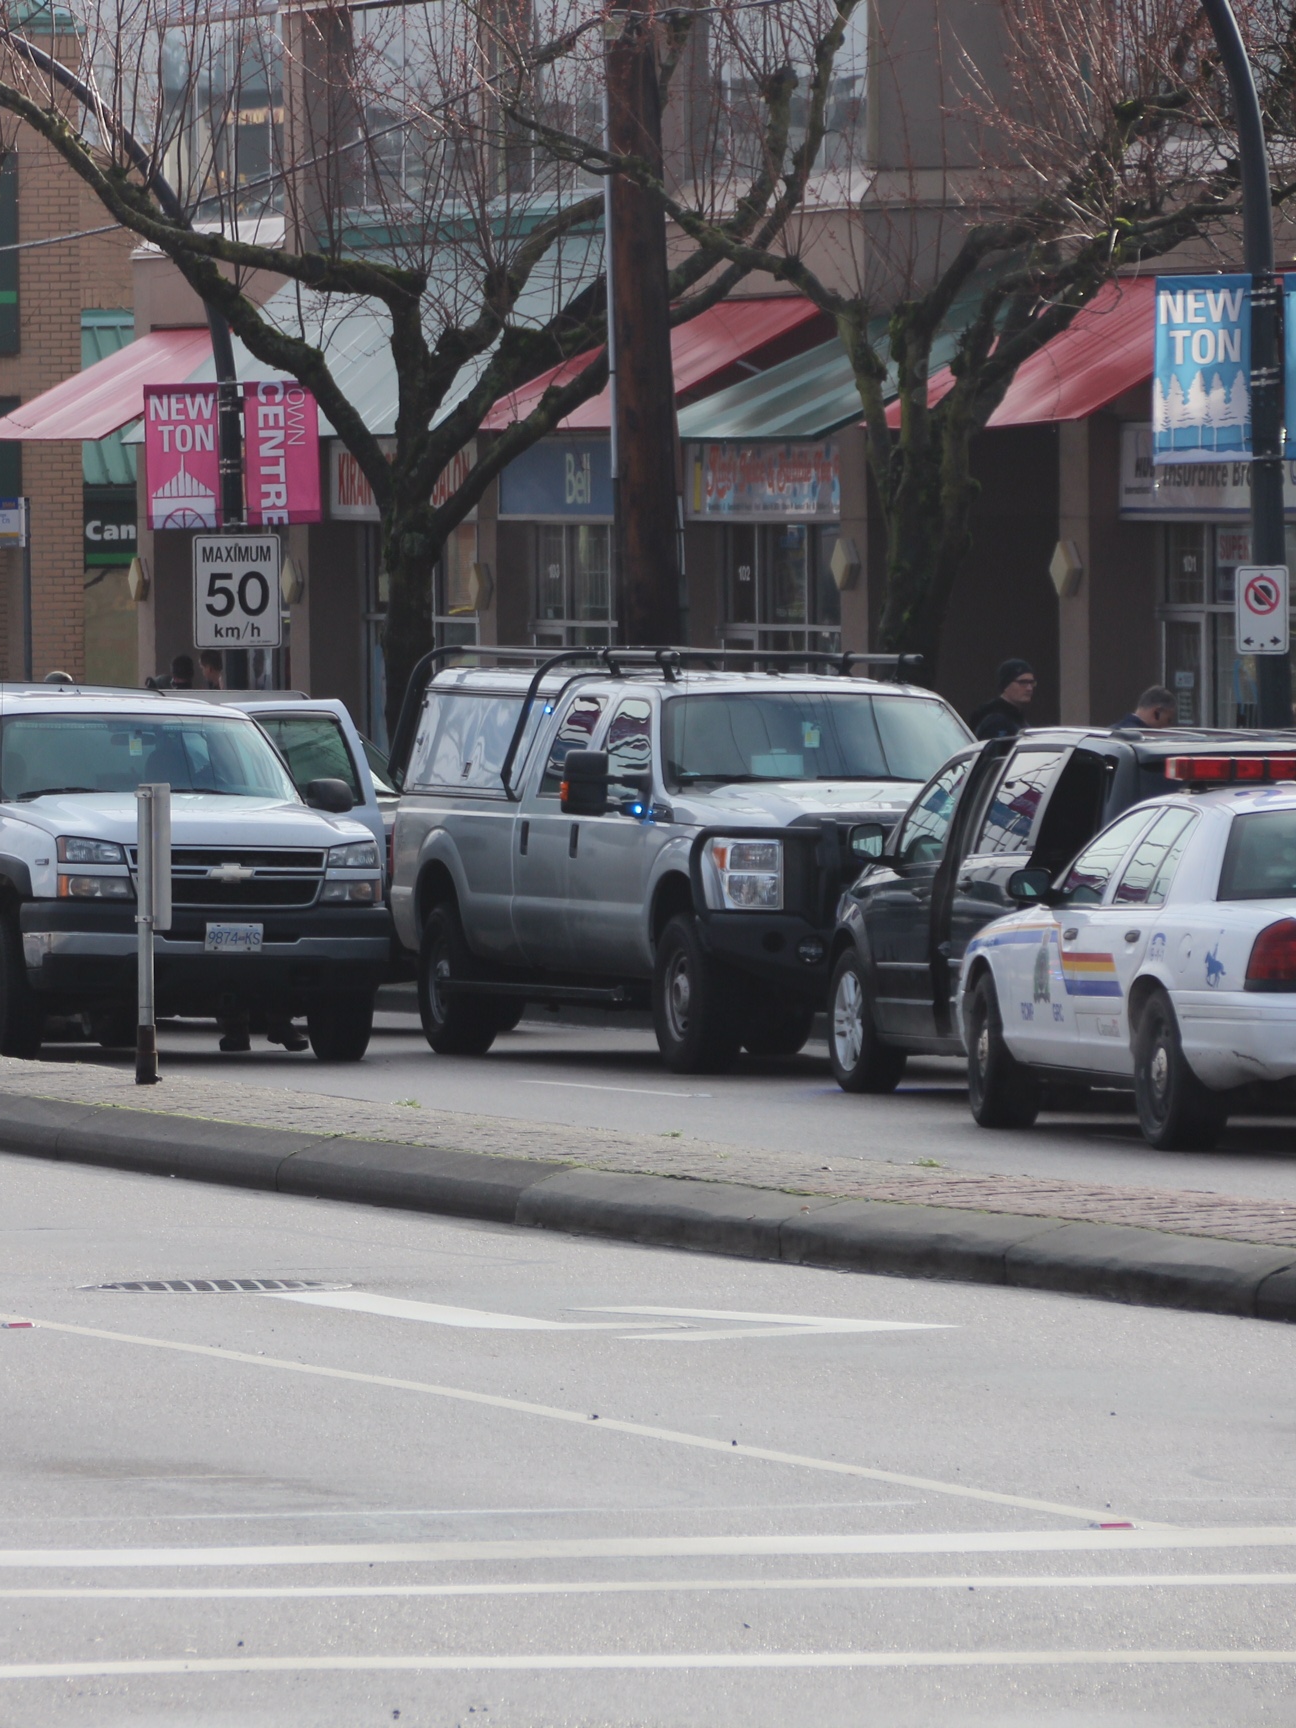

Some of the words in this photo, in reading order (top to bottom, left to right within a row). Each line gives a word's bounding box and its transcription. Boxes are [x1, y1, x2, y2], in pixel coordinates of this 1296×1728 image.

[1160, 288, 1244, 325] NEW
[1169, 328, 1241, 365] TON
[149, 393, 215, 421] NEW
[158, 424, 215, 453] TON
[257, 381, 289, 525] CENTRE
[565, 453, 591, 504] Bell
[202, 545, 271, 562] MAXIMUM
[738, 565, 750, 581] 102
[205, 571, 270, 617] 50
[214, 621, 261, 639] km/h
